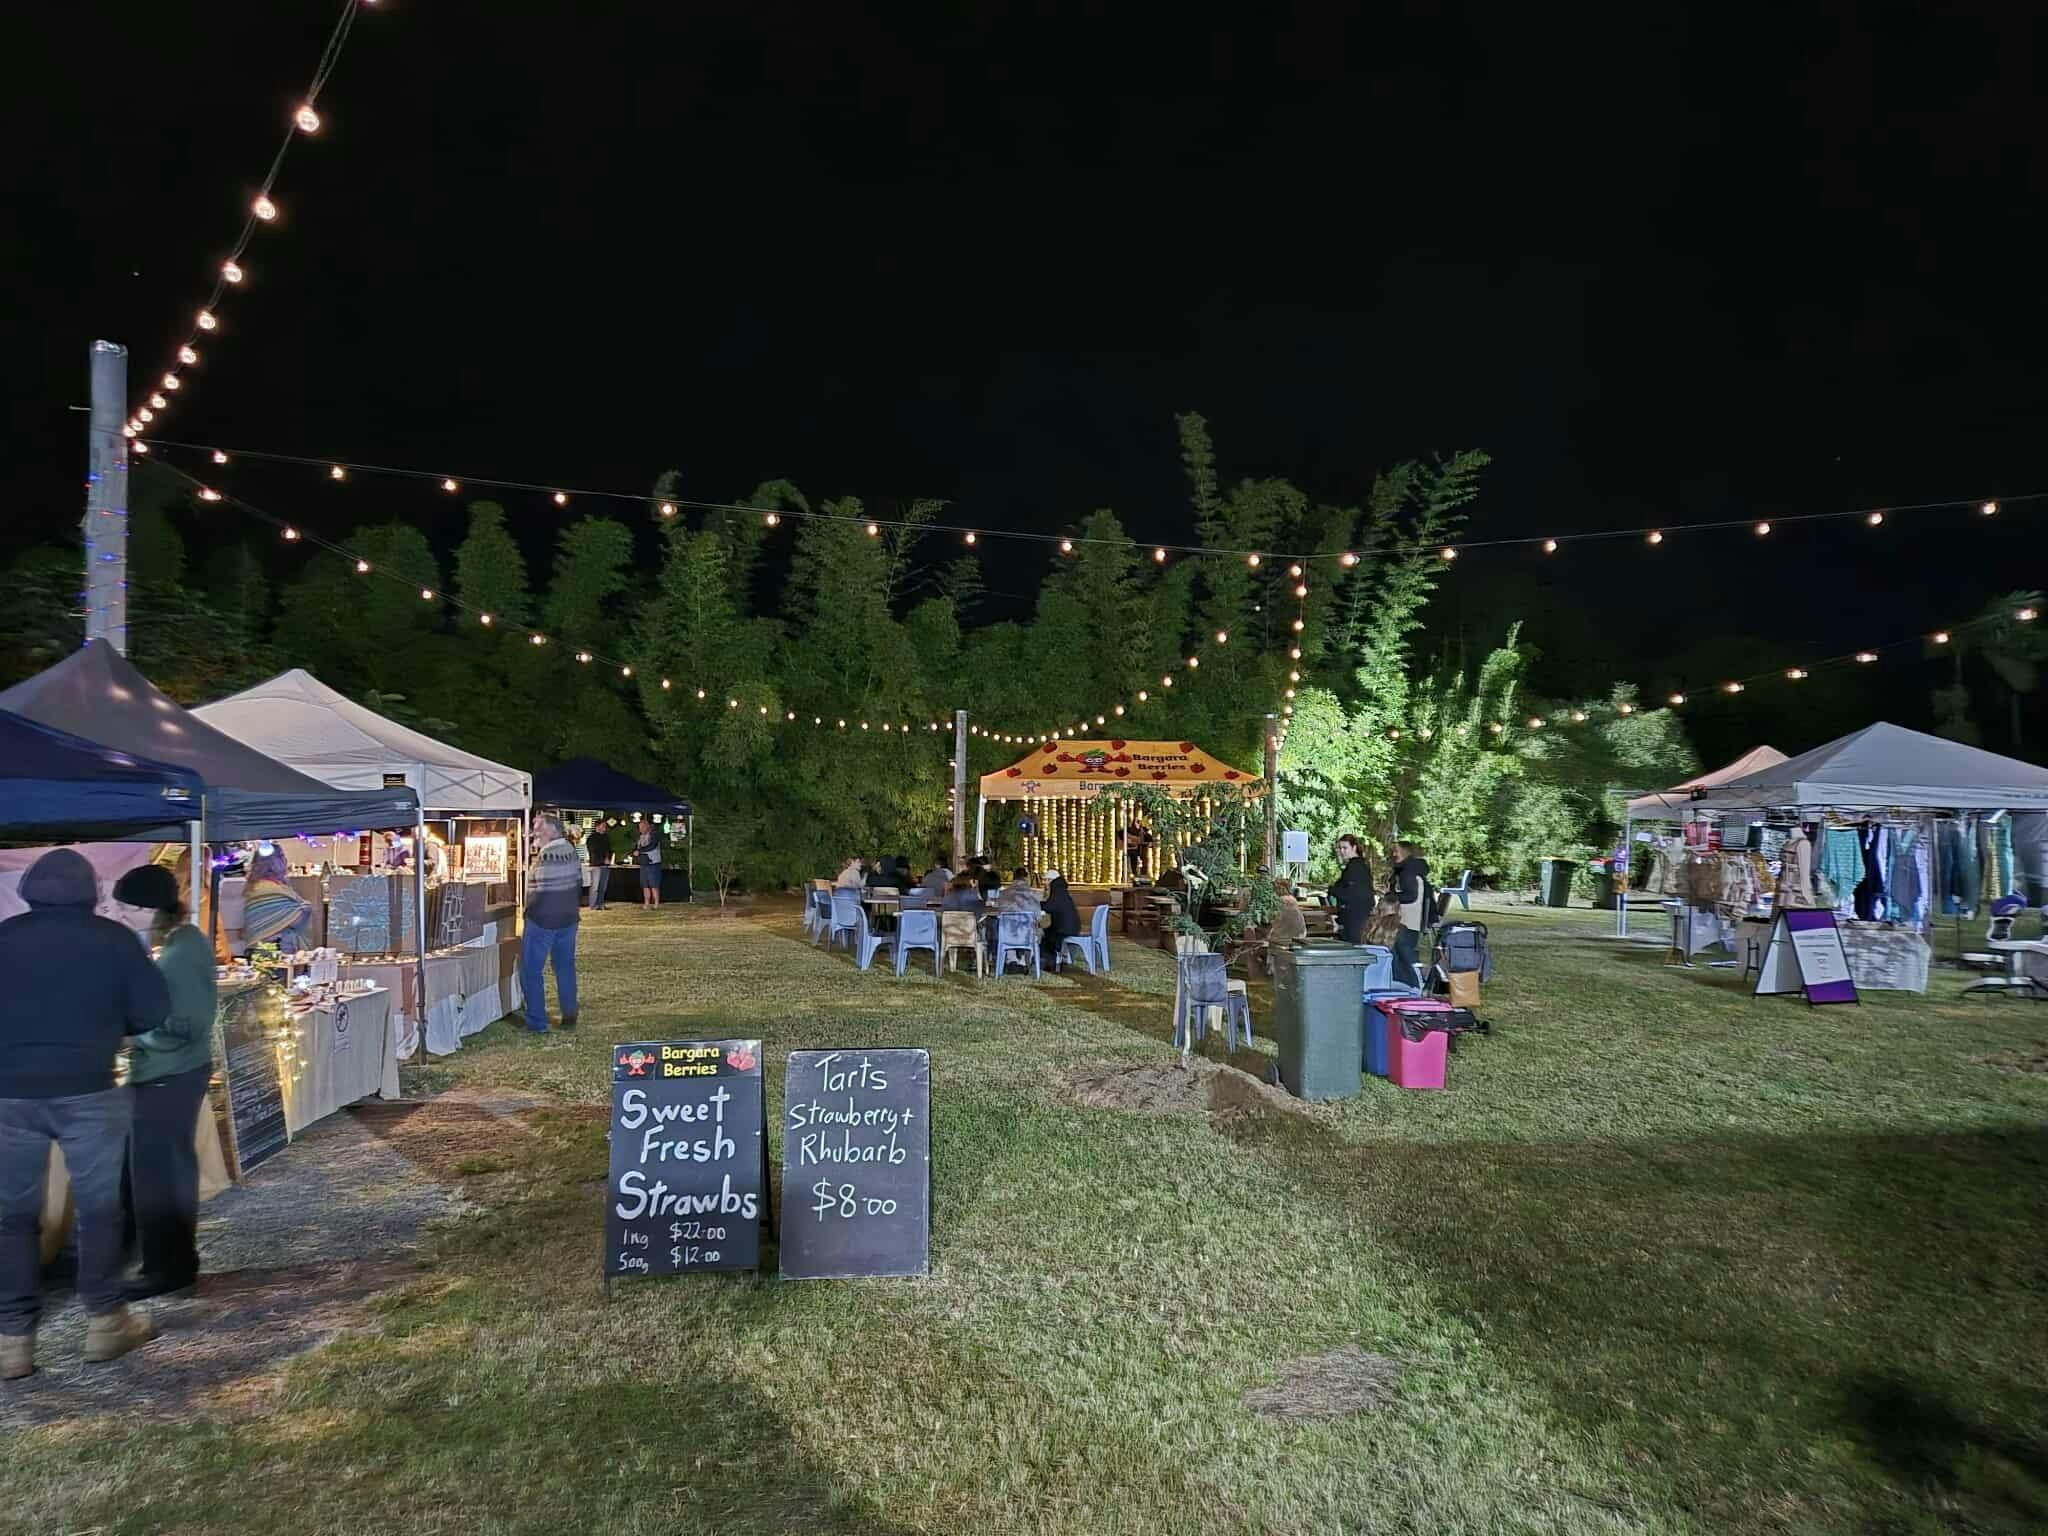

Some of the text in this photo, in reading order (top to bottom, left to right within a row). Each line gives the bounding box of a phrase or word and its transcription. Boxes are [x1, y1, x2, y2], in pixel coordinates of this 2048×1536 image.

[1132, 754, 1187, 763] Bargara
[661, 1046, 720, 1062] Bargara
[663, 1062, 718, 1077] Berries
[814, 1053, 888, 1092] Tarts
[620, 1085, 731, 1129] Sweet
[640, 1124, 736, 1164] Fresh
[800, 1129, 907, 1166] Rhubarb
[615, 1170, 758, 1221] Strawbs
[618, 1251, 649, 1274] 500g
